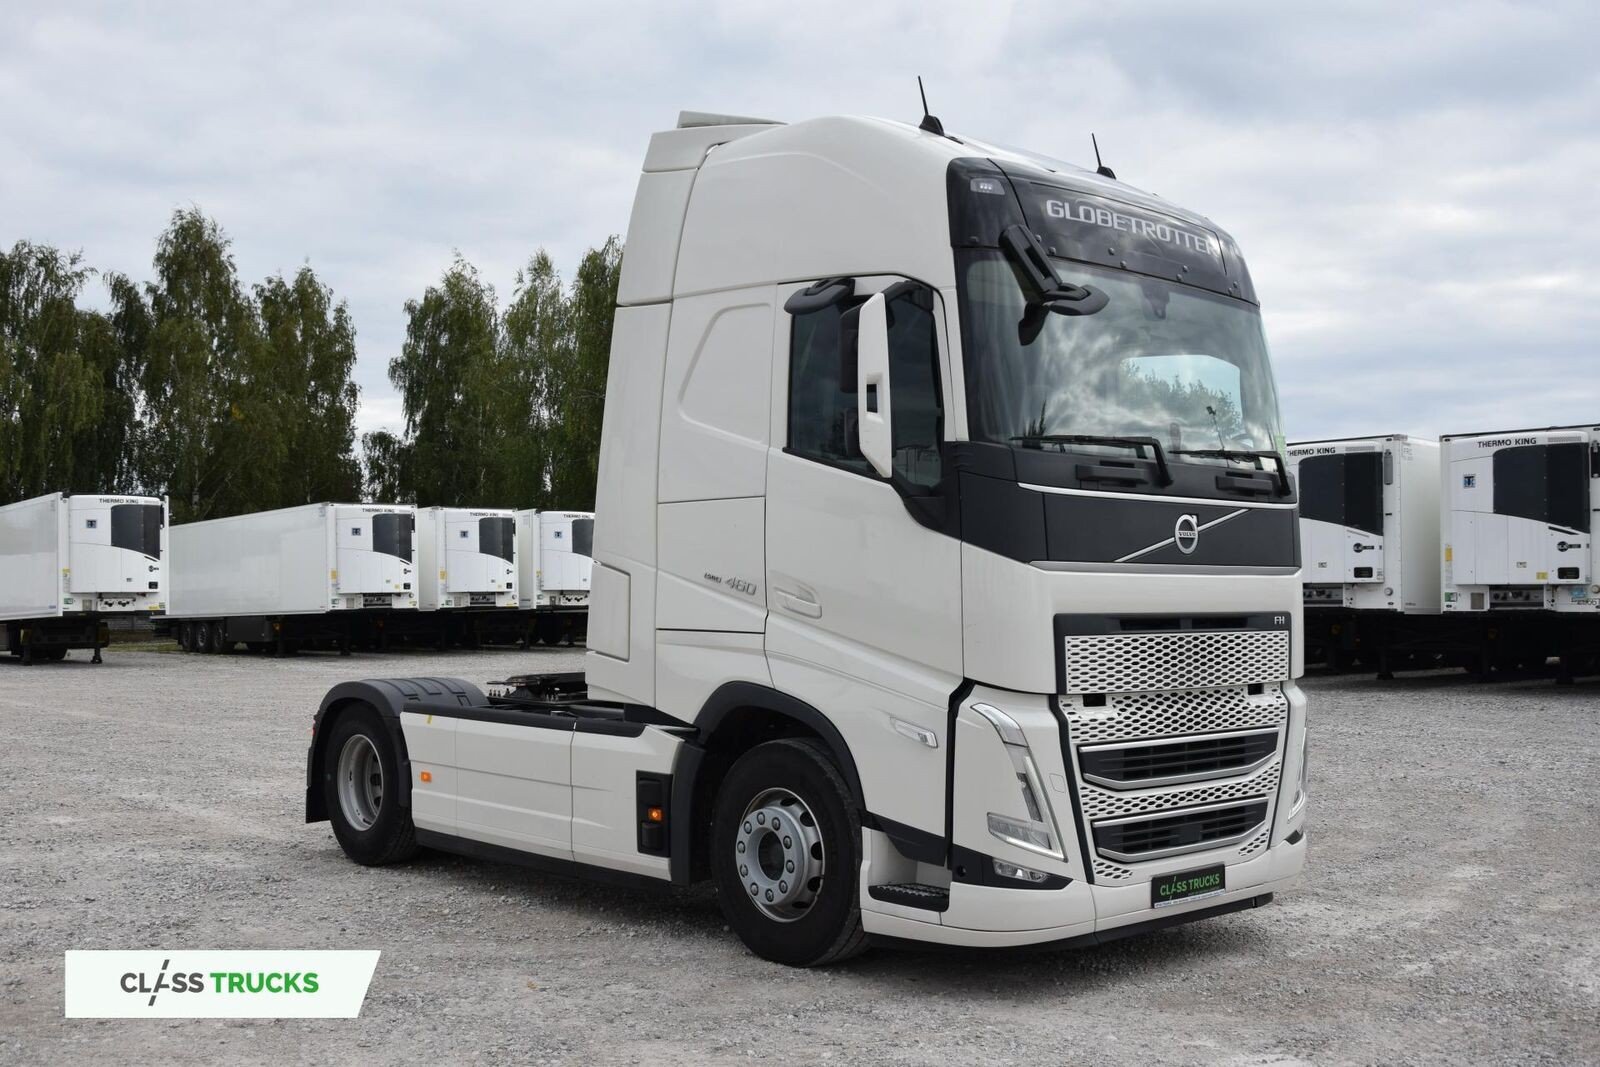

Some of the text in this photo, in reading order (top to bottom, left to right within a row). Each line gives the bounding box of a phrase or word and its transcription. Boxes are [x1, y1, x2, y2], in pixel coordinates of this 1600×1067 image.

[1477, 437, 1537, 448] THERMO KING
[1316, 447, 1336, 455] KING
[725, 576, 757, 596] 460
[1274, 616, 1285, 624] FH
[1160, 876, 1188, 901] CLASS
[1188, 873, 1220, 890] TRUCKS
